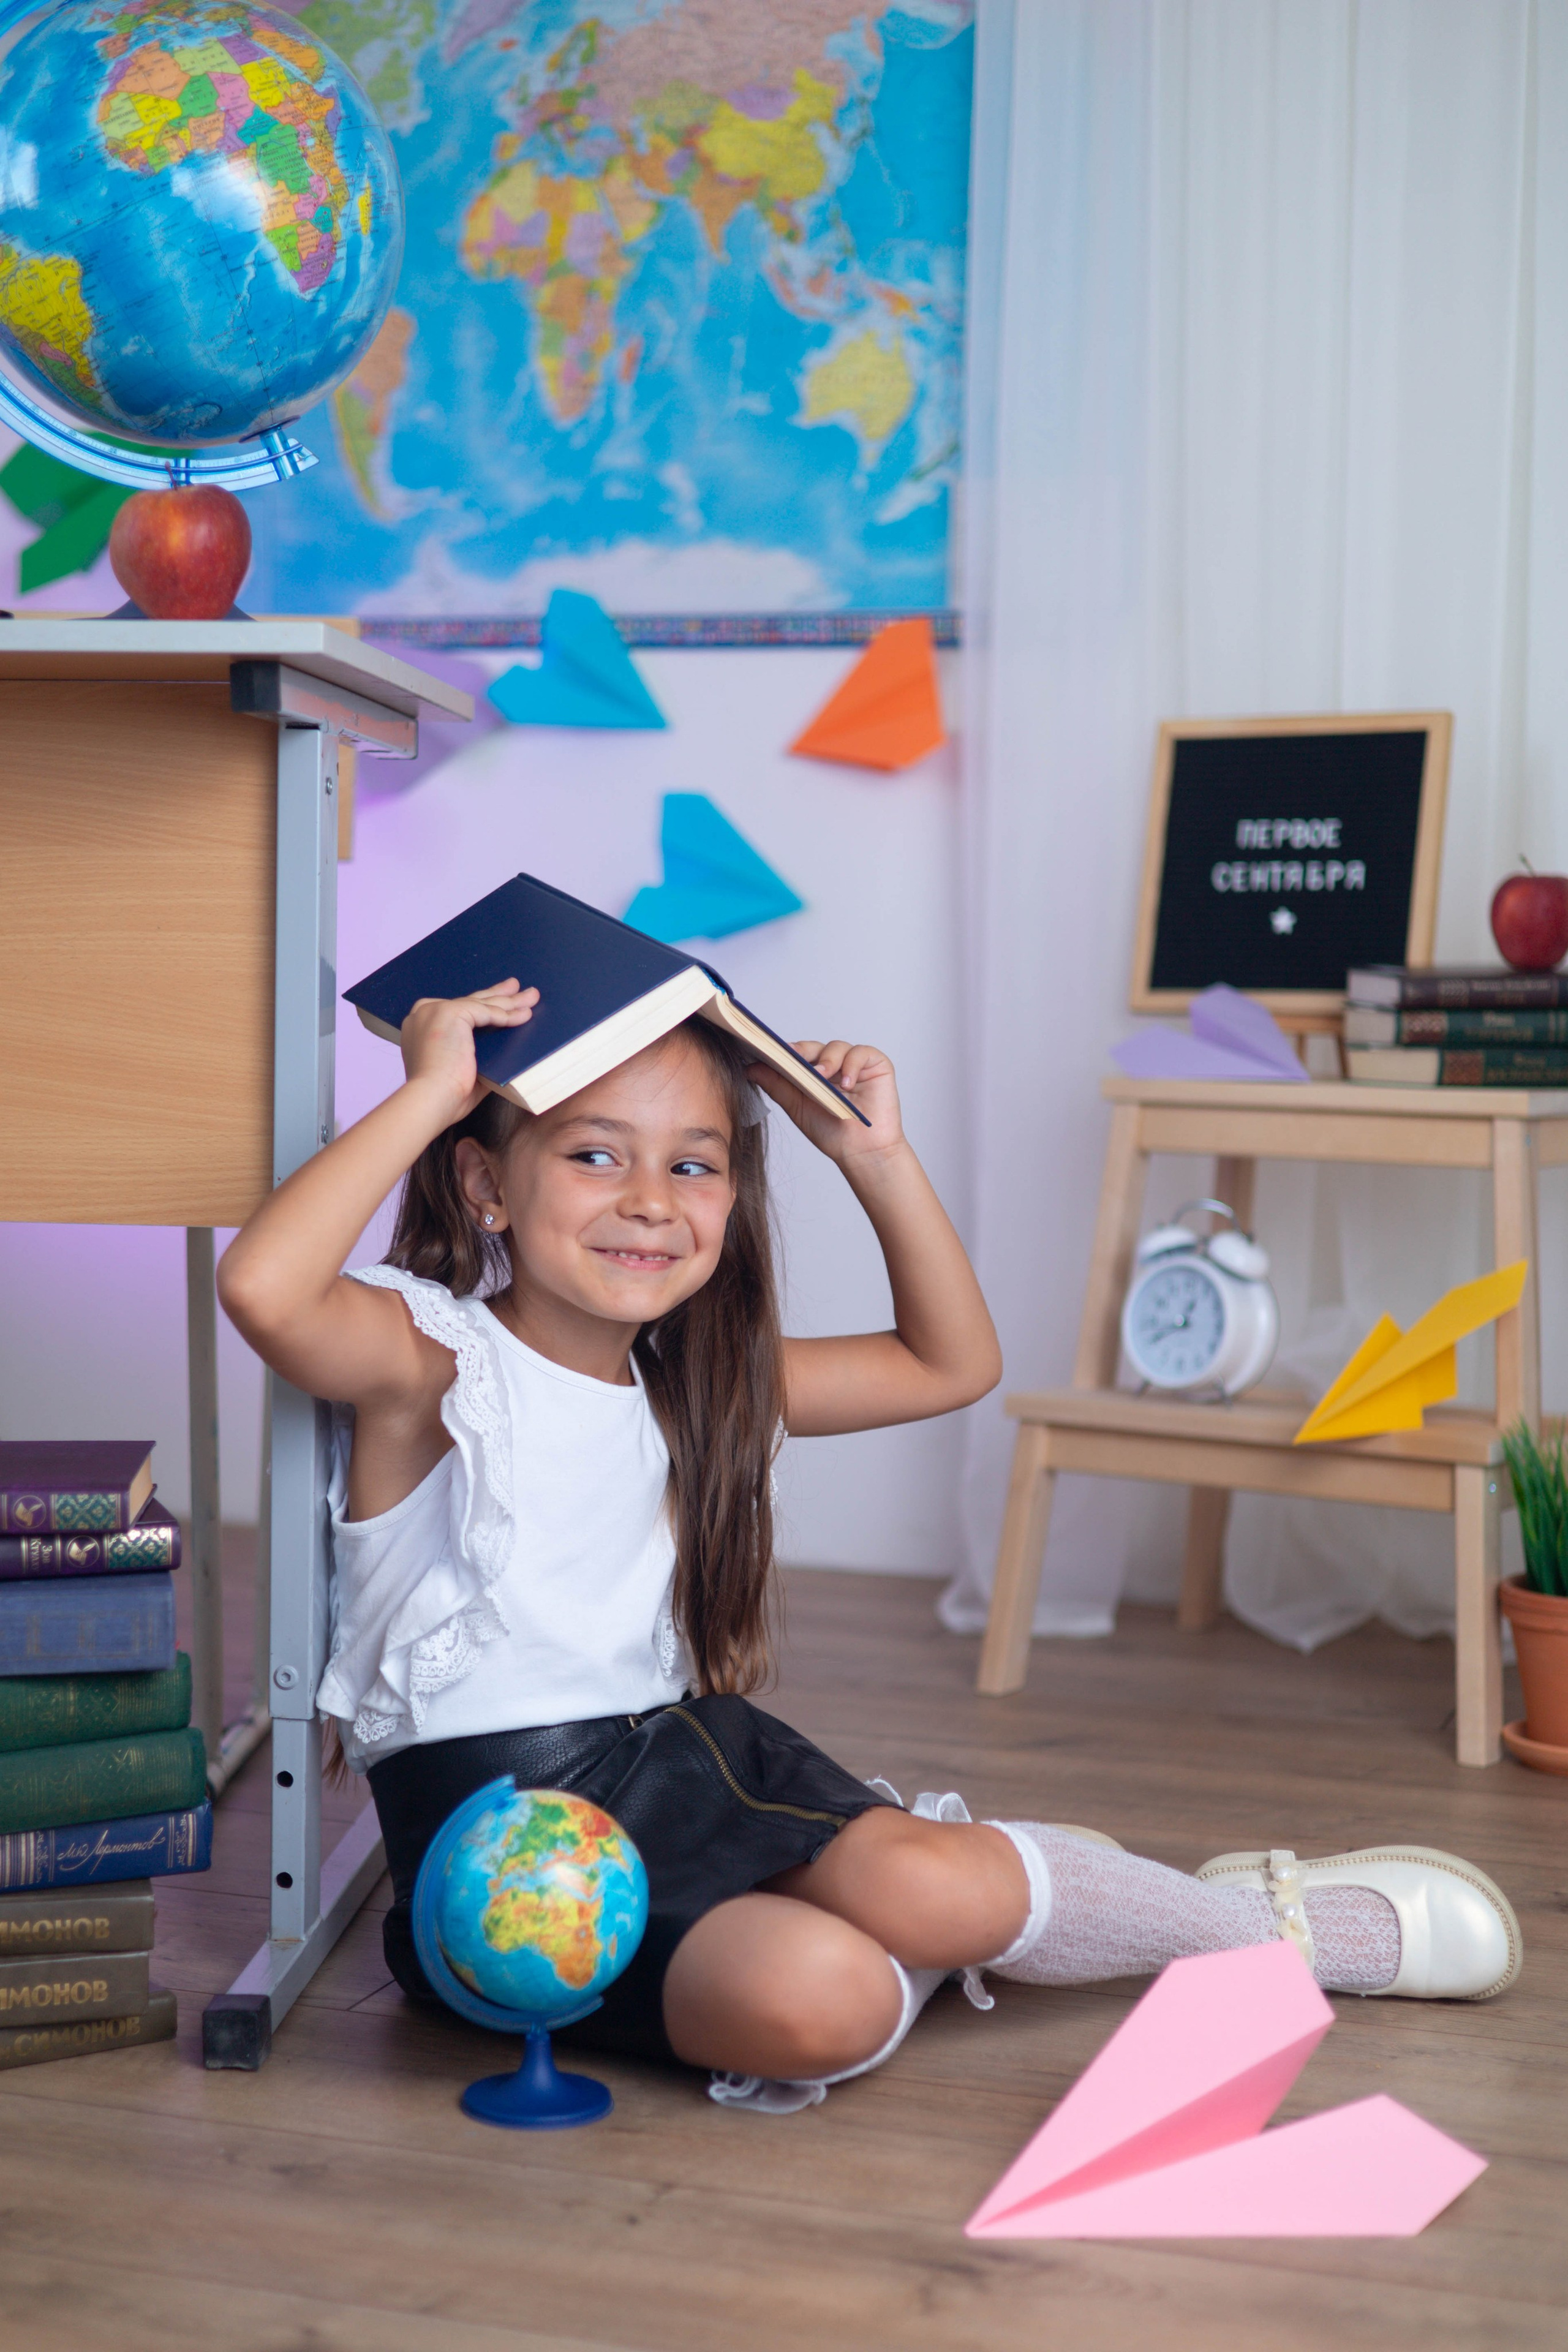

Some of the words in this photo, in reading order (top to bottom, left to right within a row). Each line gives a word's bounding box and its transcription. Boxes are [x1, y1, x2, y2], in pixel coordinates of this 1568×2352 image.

[1236, 817, 1343, 850] ПЕРВОЕ
[1211, 859, 1366, 893] СЕНТЯБРЯ
[13, 2016, 141, 2056] СИМОНОВ
